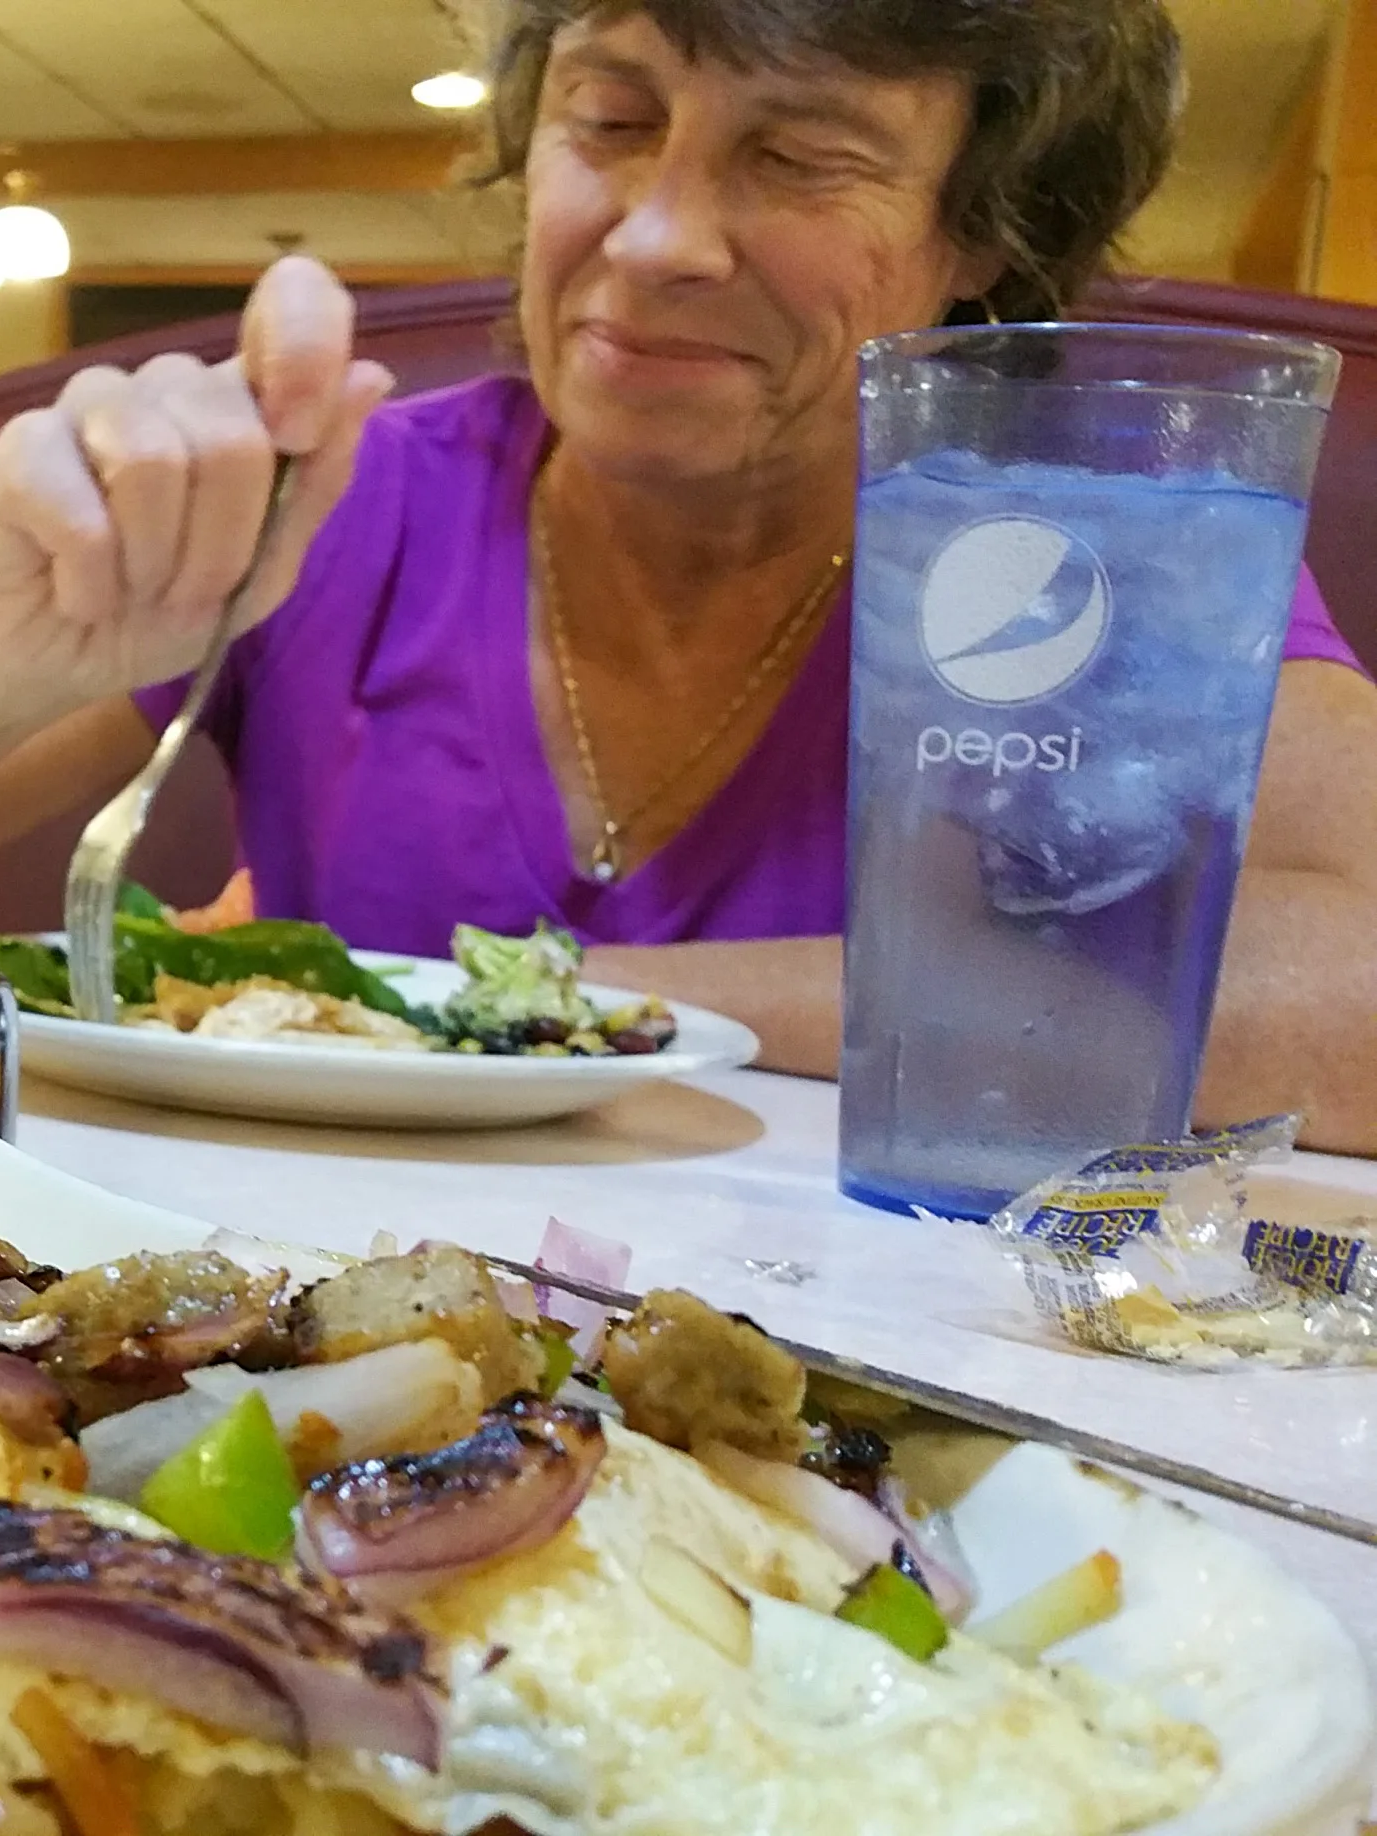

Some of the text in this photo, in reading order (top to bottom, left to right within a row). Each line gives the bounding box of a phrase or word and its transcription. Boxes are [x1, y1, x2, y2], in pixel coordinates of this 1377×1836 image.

[916, 724, 1083, 777] pepsi
[1032, 1209, 1146, 1240] RECIPE
[1255, 1222, 1350, 1260] RECIPE
